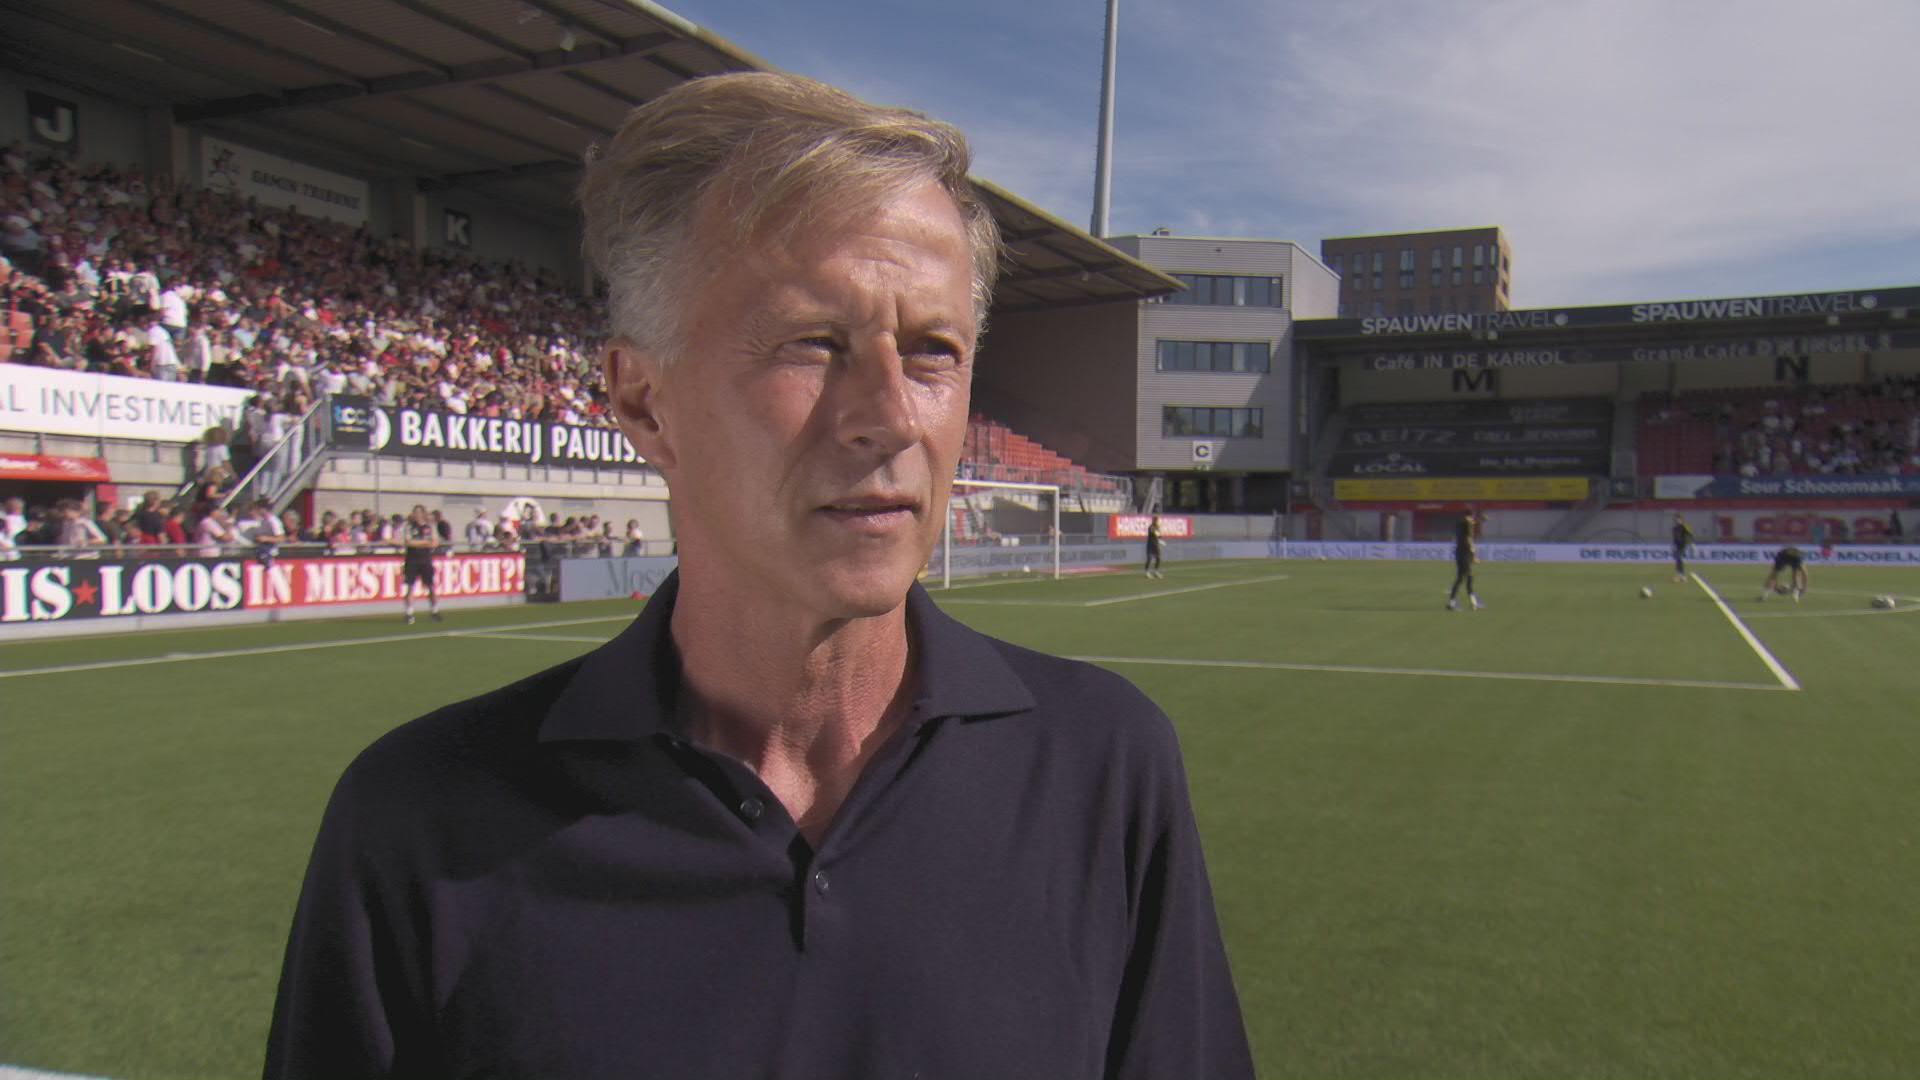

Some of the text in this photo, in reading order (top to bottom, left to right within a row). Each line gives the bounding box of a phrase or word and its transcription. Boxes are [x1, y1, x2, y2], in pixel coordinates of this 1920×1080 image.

[33, 106, 73, 143] J
[447, 213, 469, 247] K
[1374, 350, 1564, 371] Café IN DE KARKOL
[1775, 356, 1809, 382] N
[1453, 369, 1495, 393] M
[401, 410, 647, 464] BAKKERIJ PAULIS
[1195, 445, 1209, 458] C
[1784, 477, 1904, 494] Schoonmaak
[0, 565, 73, 622] IS
[99, 562, 243, 616] LOOS
[247, 556, 526, 606] IN MESTEECH?!
